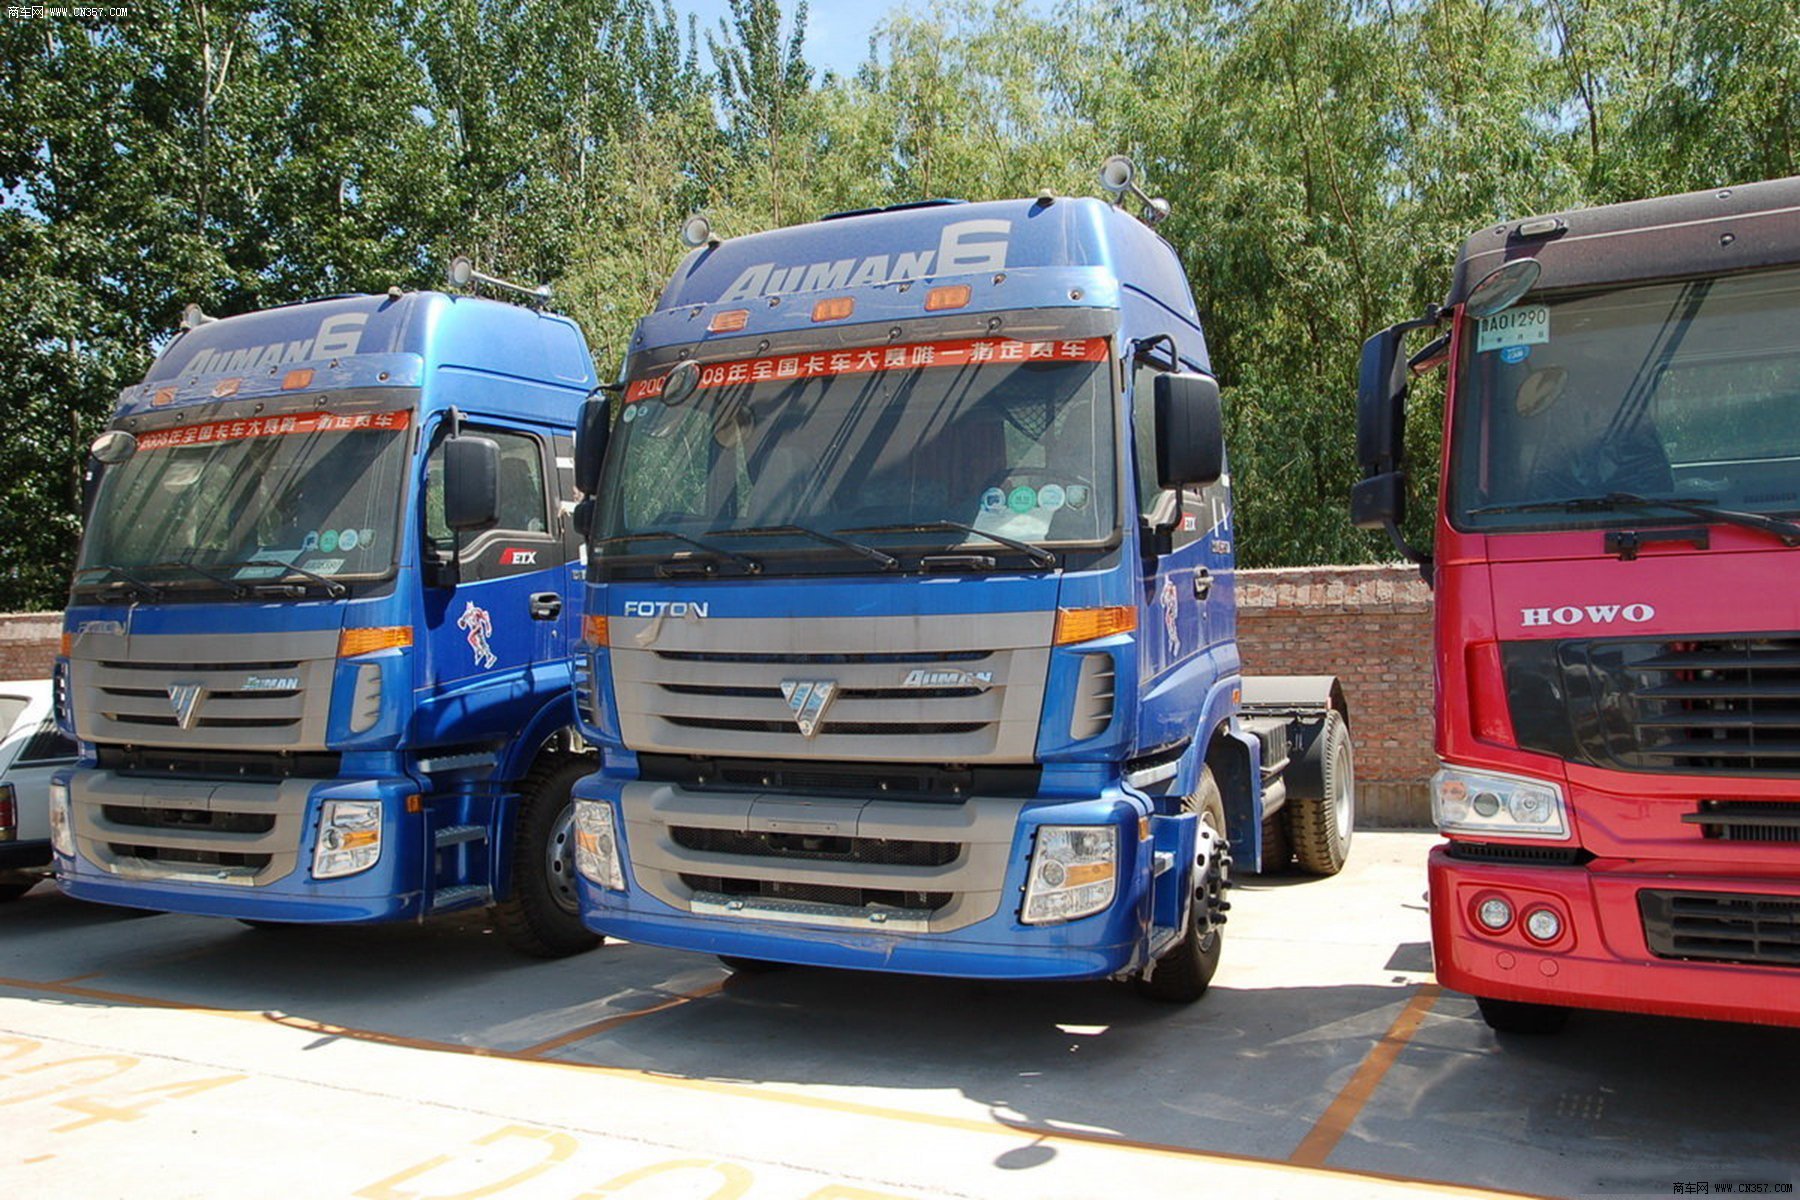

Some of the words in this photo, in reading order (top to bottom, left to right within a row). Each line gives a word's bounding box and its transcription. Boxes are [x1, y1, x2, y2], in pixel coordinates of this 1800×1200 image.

[511, 551, 537, 565] ETX
[624, 601, 709, 618] FOTON
[1520, 603, 1656, 627] HOWO
